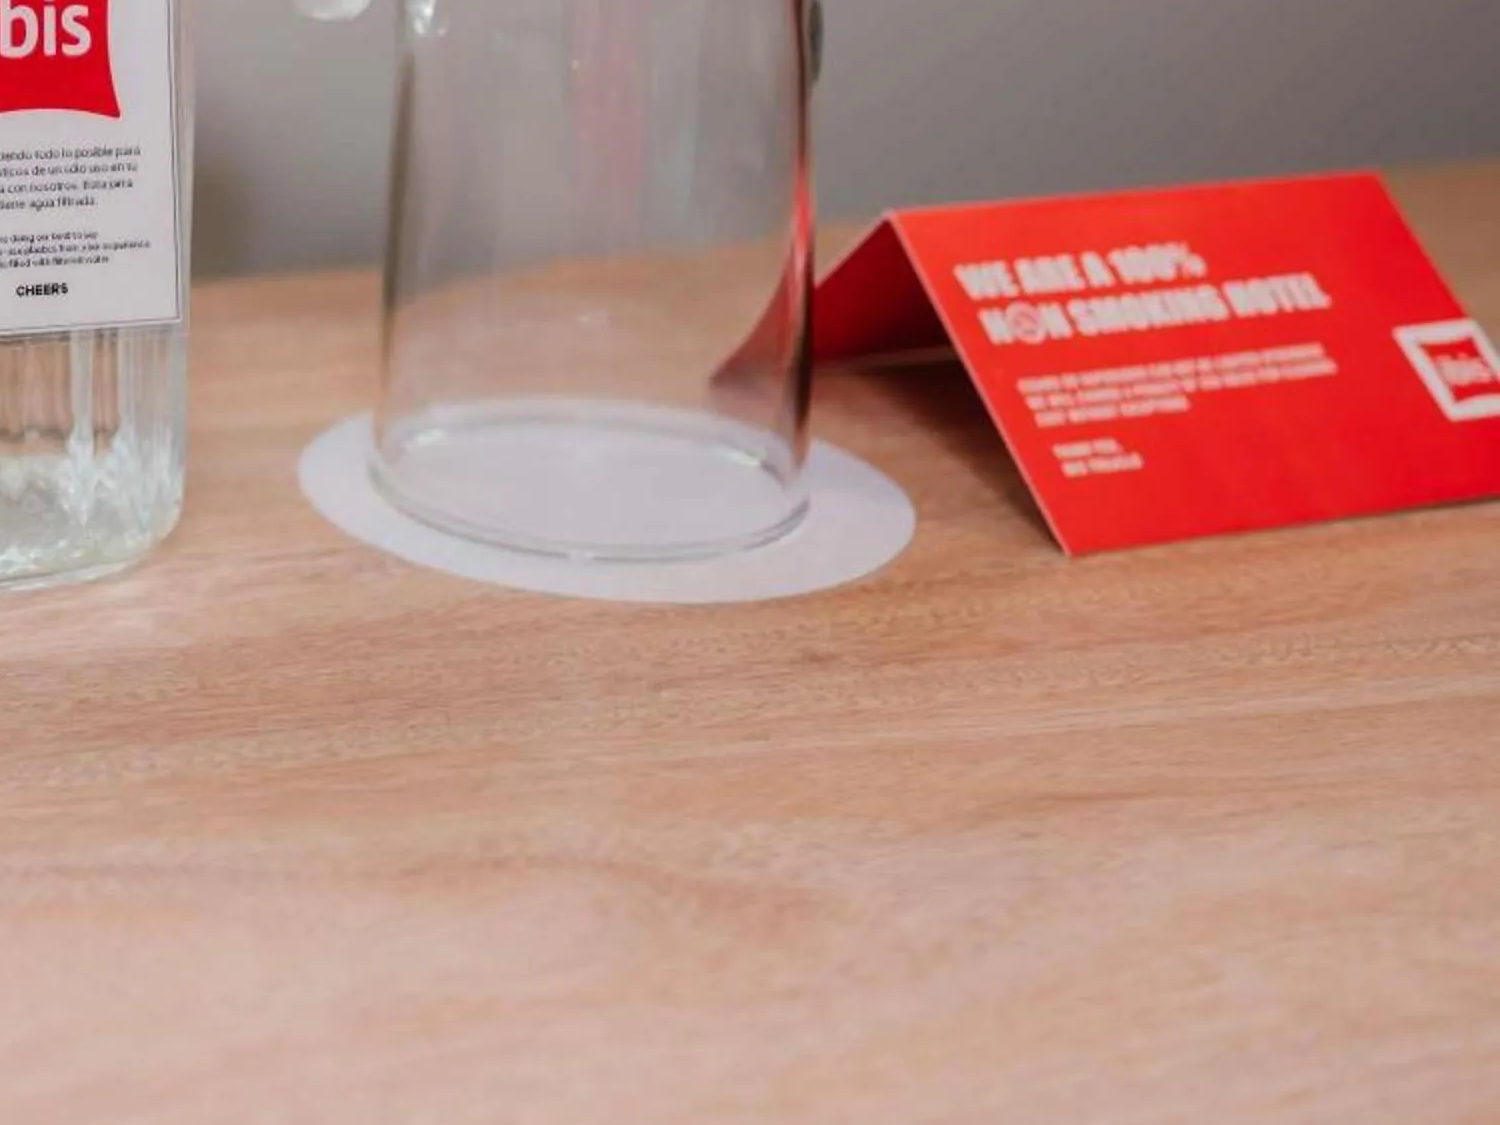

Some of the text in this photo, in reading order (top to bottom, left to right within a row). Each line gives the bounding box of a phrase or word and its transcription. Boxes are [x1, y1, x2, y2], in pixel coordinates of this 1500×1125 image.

[16, 282, 69, 296] CHEERS
[953, 259, 1020, 302] WE
[1079, 250, 1118, 289] A
